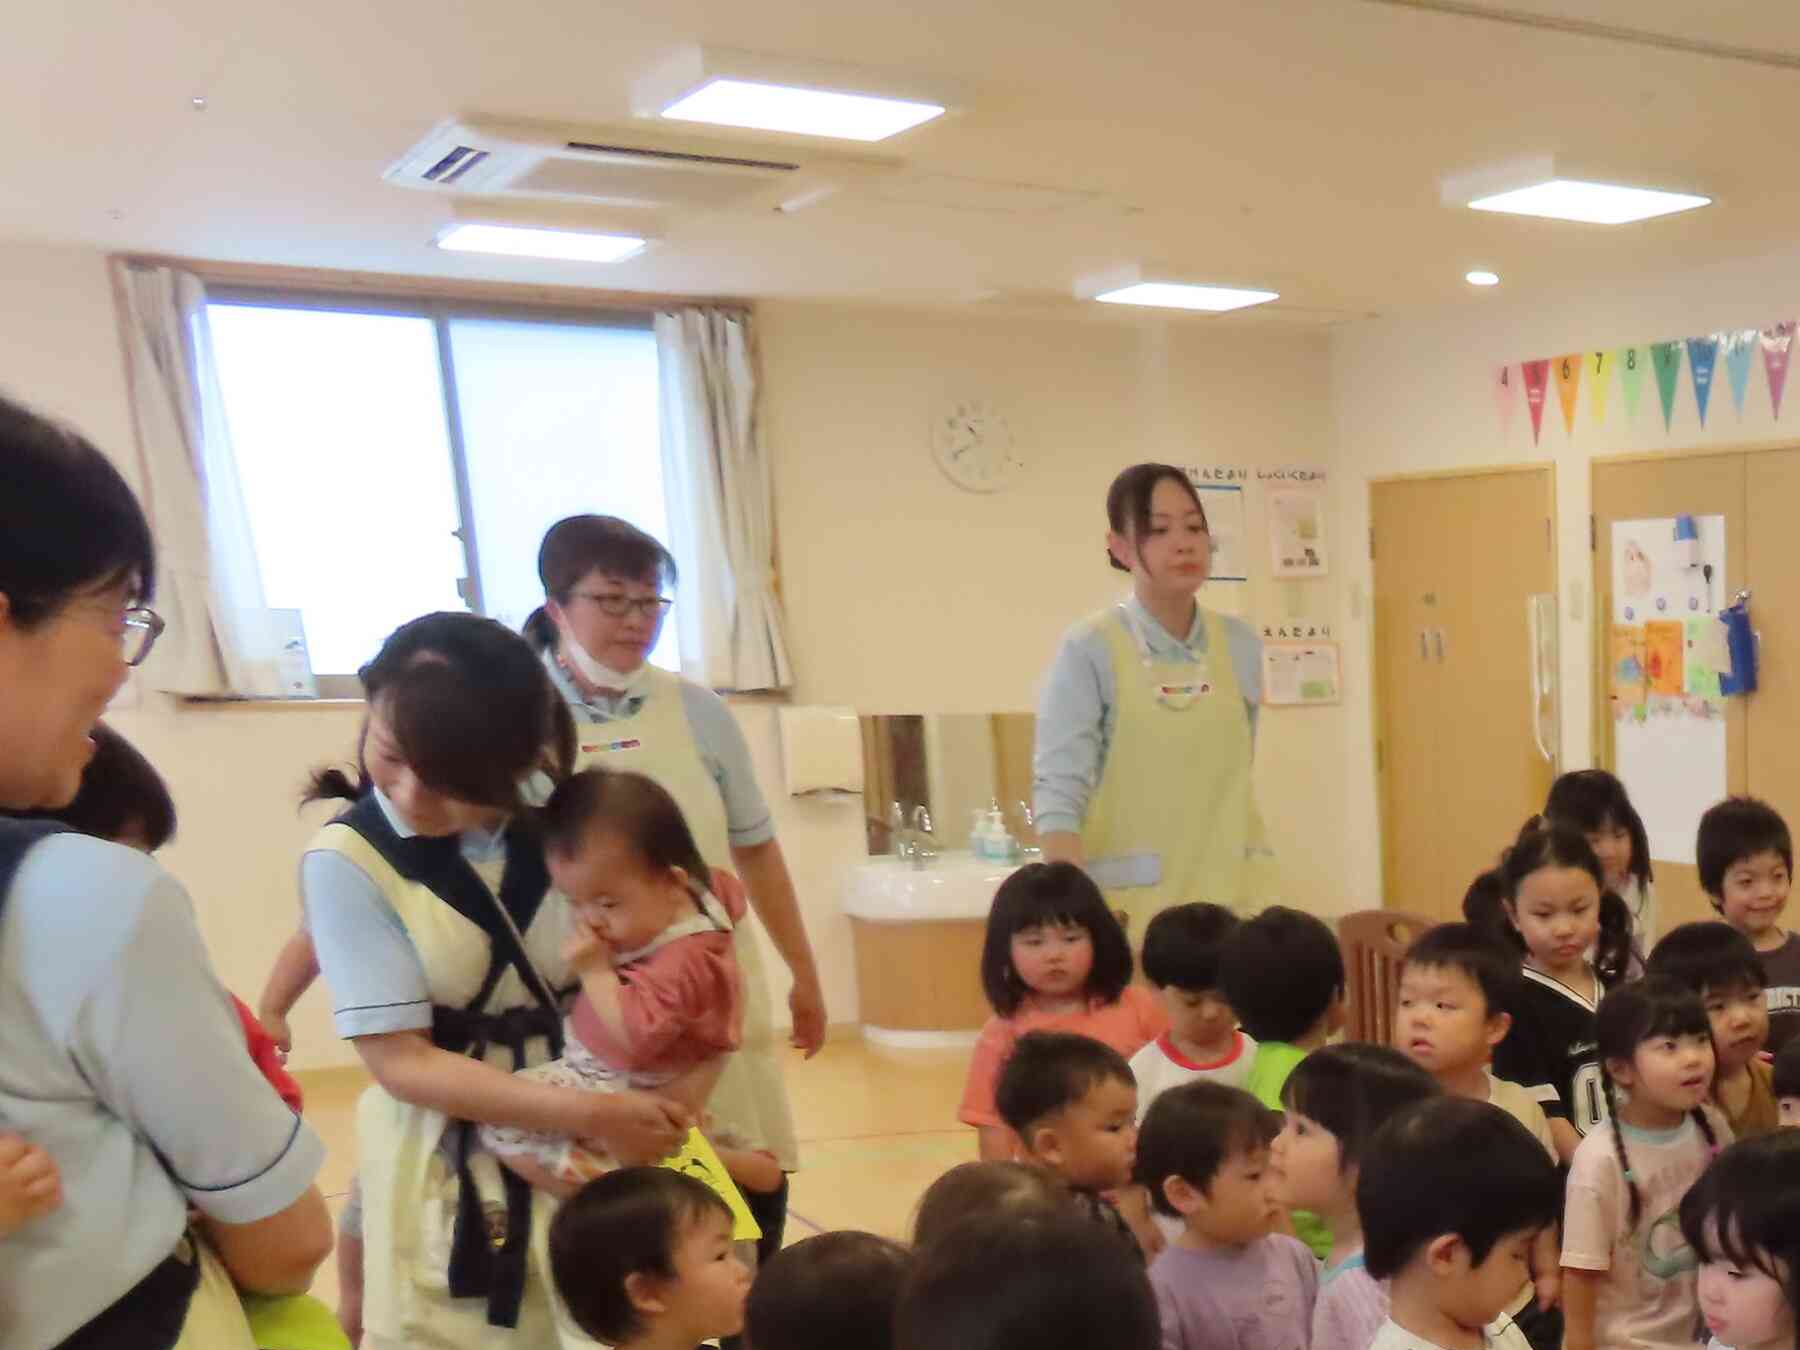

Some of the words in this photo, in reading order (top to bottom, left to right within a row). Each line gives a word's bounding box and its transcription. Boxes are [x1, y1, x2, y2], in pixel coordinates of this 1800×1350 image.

[1562, 358, 1571, 380] 6
[1595, 351, 1604, 373] 7
[1627, 349, 1636, 371] 8
